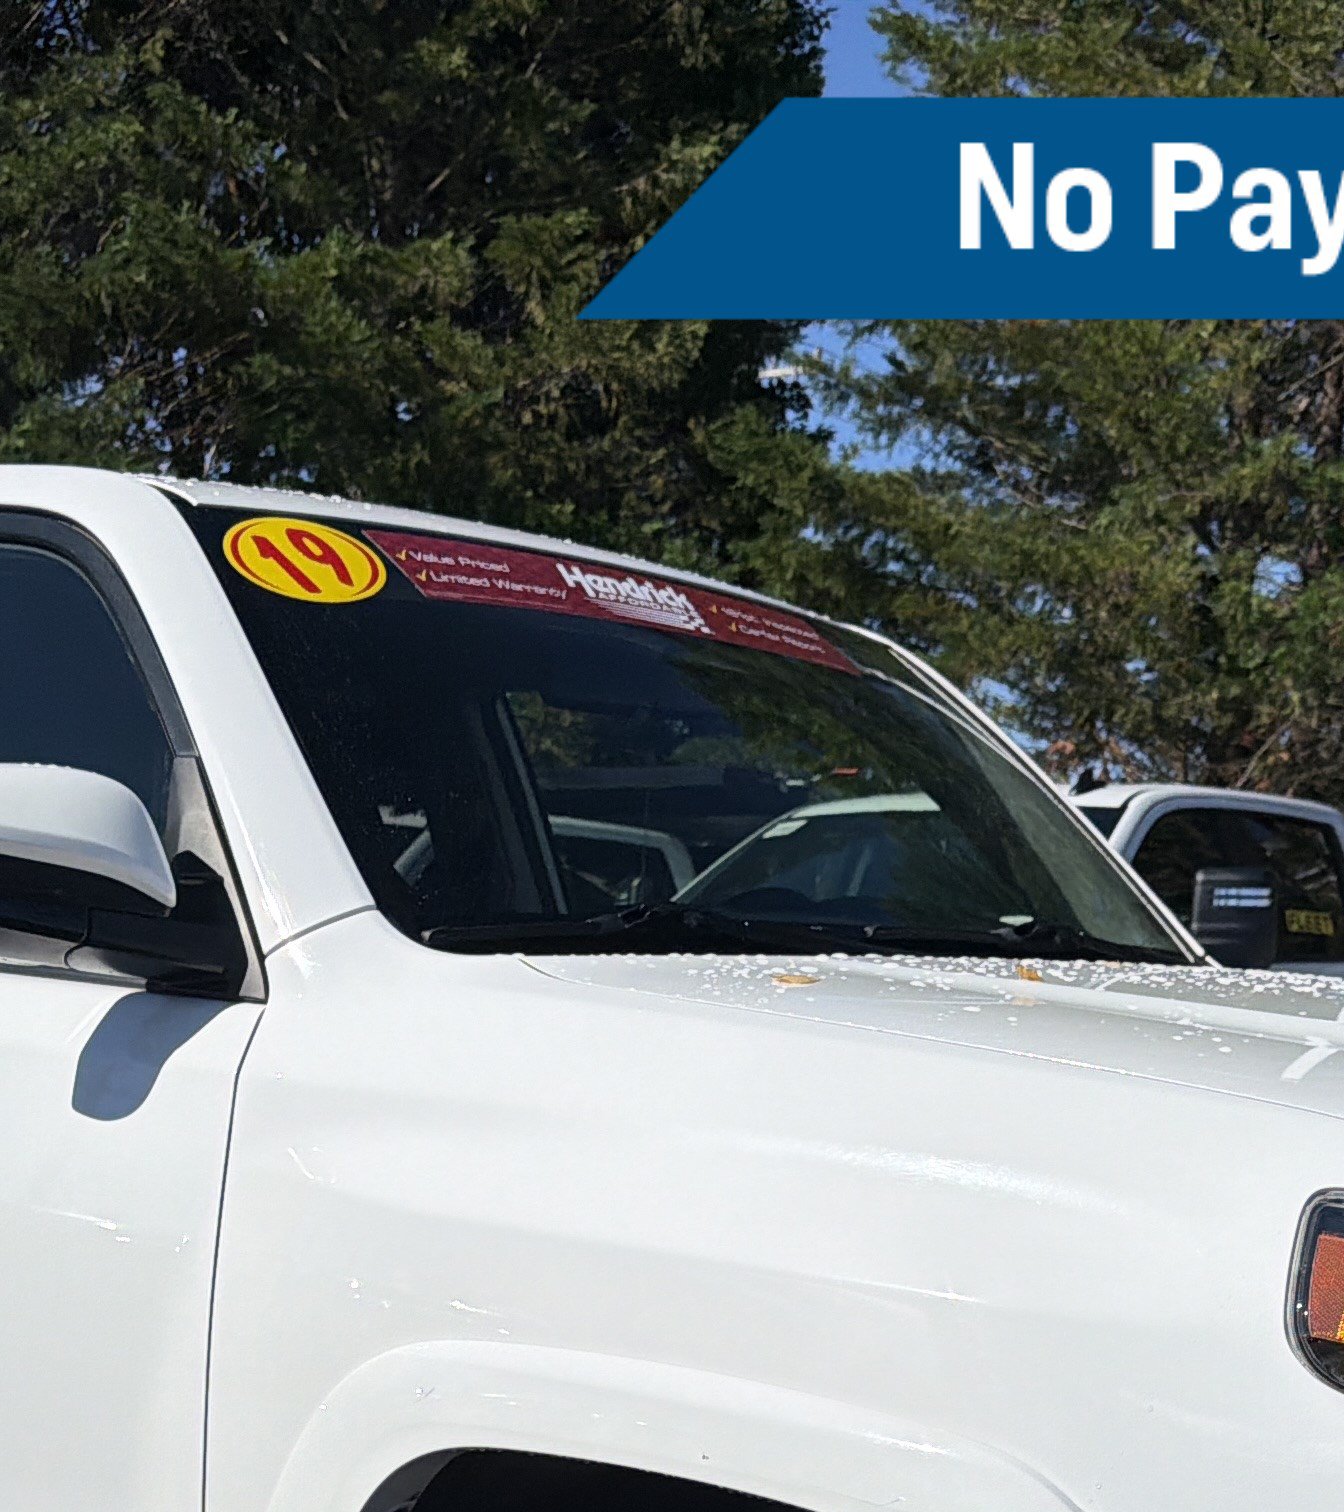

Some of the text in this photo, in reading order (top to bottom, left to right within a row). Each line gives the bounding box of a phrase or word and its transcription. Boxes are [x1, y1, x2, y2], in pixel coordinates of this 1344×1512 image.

[250, 527, 355, 594] 19
[408, 549, 511, 574] Value Priced
[430, 571, 568, 601] Limited Warranty
[556, 563, 694, 611] Hendrick
[1288, 912, 1333, 933] FLEET
